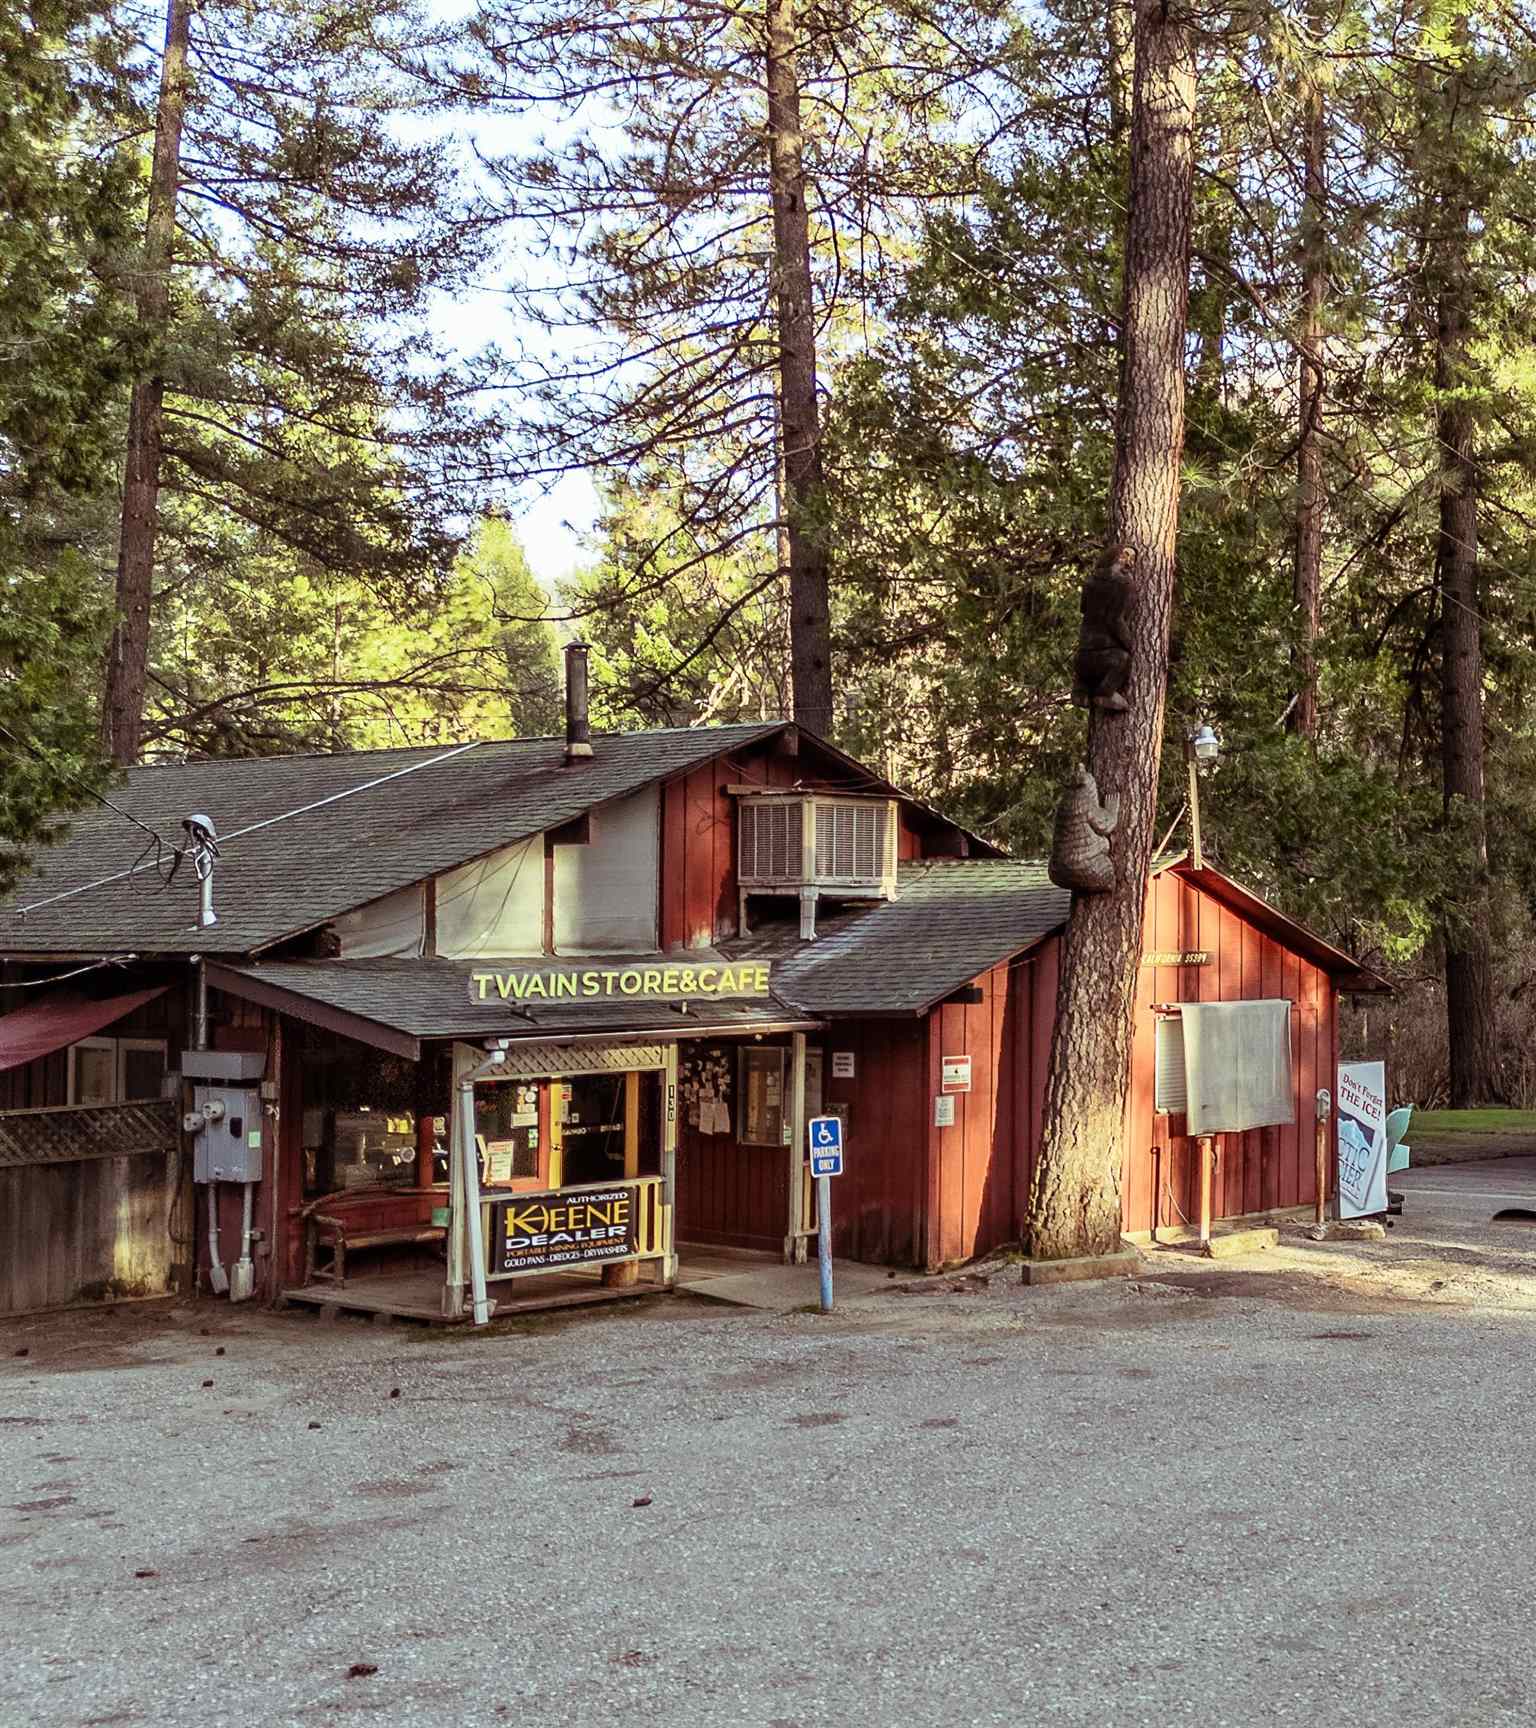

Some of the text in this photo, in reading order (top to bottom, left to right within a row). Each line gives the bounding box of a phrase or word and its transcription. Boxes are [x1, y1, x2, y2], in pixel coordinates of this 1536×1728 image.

[473, 967, 770, 999] TWAIN STORE&CAFE
[1343, 1073, 1383, 1107] Don't Forget
[1340, 1086, 1382, 1121] THE ICE!
[814, 1145, 840, 1158] PARKING
[819, 1159, 835, 1171] ONLY
[566, 1192, 628, 1205] AUTHORIZED
[504, 1200, 630, 1237] KEENE
[505, 1226, 627, 1249] DEALER
[506, 1236, 625, 1258] PORTABLE MINING EQUIPMENT
[504, 1257, 526, 1268] GOLD
[527, 1254, 545, 1265] PANS
[549, 1251, 580, 1263] DREDGES
